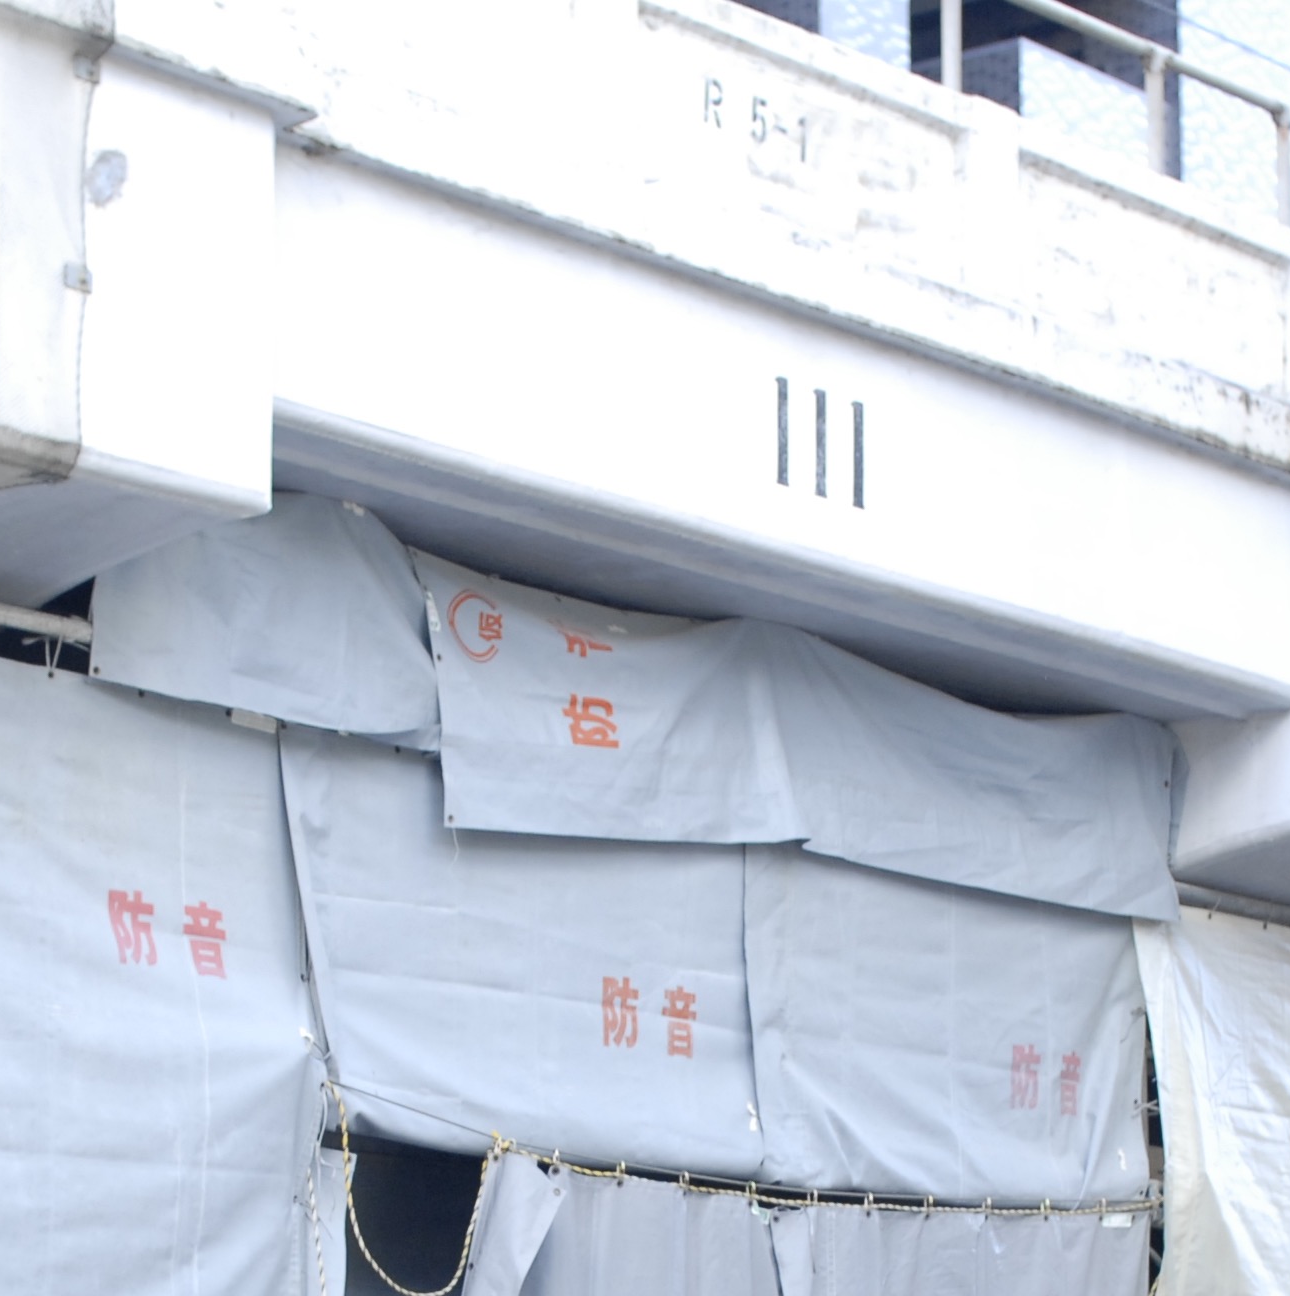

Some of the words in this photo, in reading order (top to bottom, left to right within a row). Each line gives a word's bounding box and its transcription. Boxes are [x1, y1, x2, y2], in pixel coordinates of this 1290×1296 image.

[750, 96, 807, 162] 5-1
[775, 376, 865, 508] 111
[108, 889, 227, 979] 防音
[602, 976, 697, 1059] 防音
[1010, 1044, 1082, 1116] 防音
